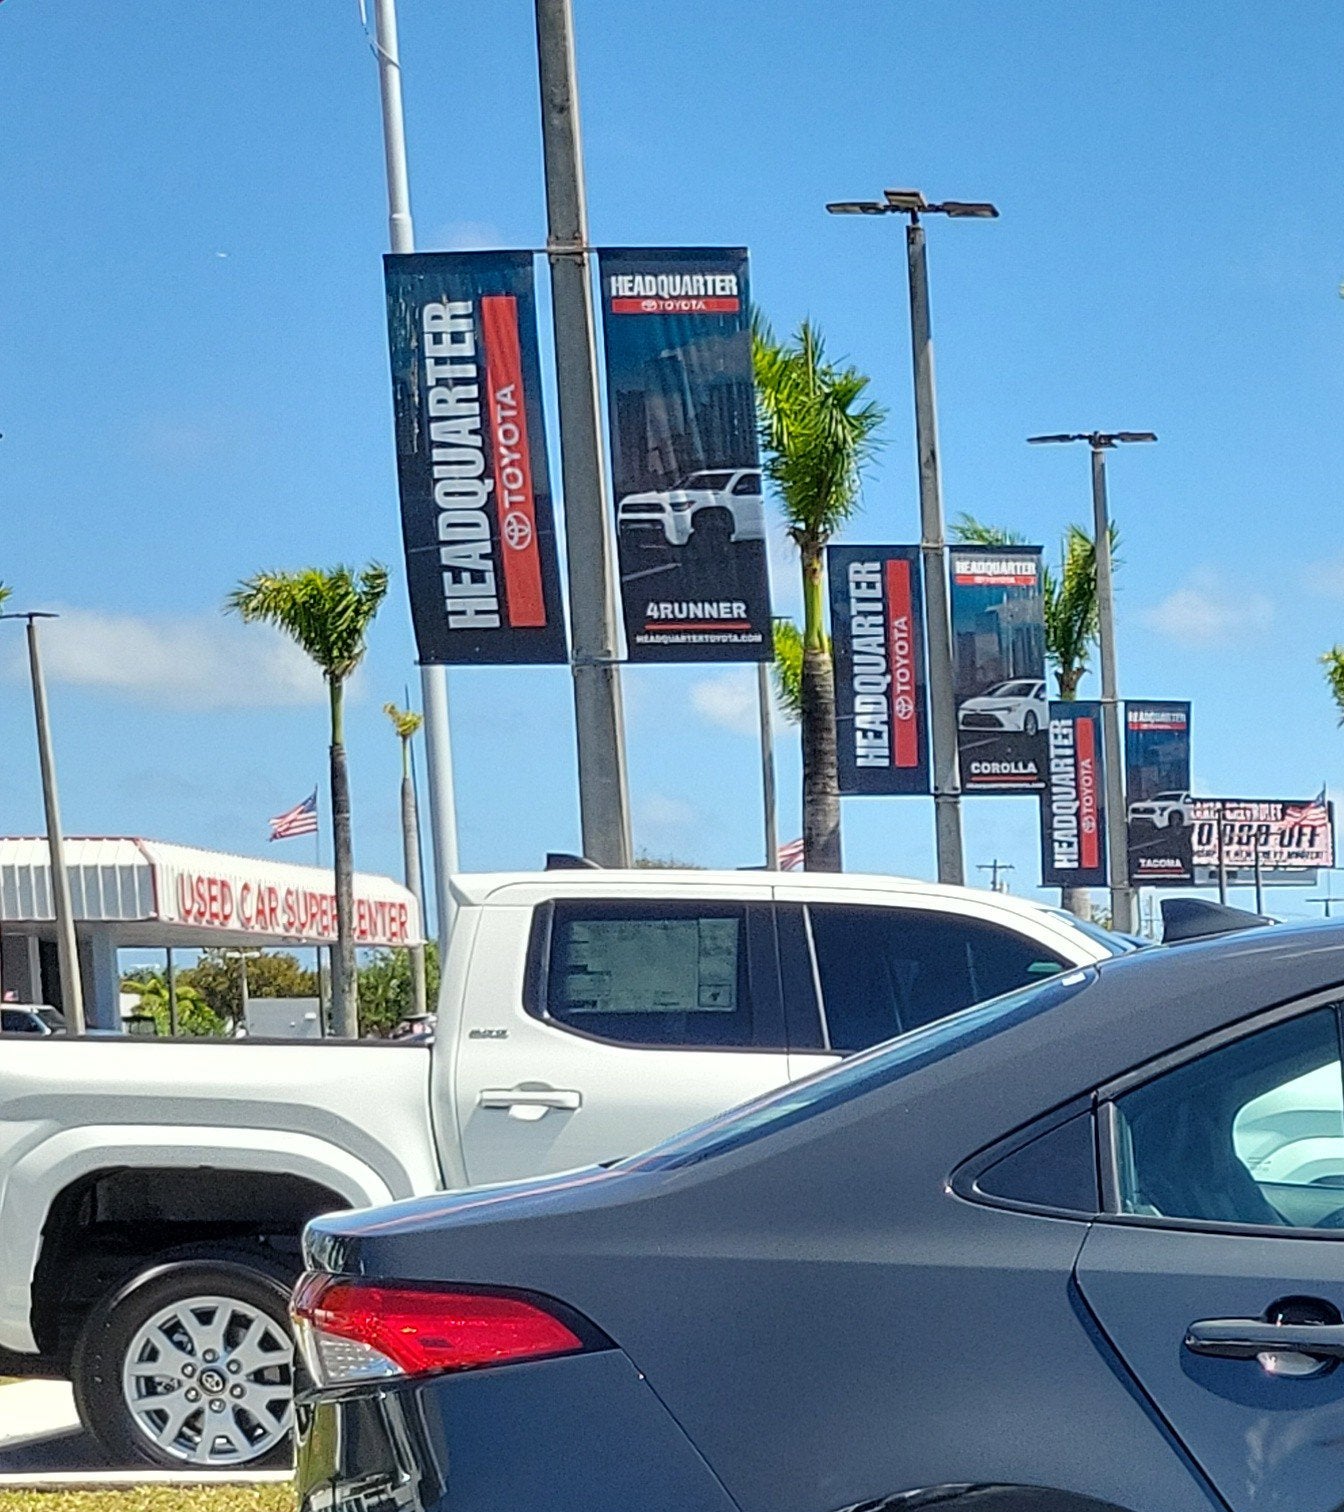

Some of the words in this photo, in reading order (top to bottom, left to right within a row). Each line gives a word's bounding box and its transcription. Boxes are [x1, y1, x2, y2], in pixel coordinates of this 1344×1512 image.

[610, 274, 738, 299] HEADQUARTER
[657, 300, 706, 311] TOYOTA
[423, 299, 501, 630] HEADQUARTER
[496, 383, 527, 507] TOYOTA
[955, 560, 1037, 576] HEADQUARTER
[646, 601, 748, 620] 4RUNNER
[849, 560, 891, 768] HEADQUARTER
[894, 616, 911, 693] TOYOTA
[970, 761, 1038, 774] COROLLA
[1050, 718, 1080, 869] HEADQUARTER
[1081, 758, 1094, 817] TOYOTA
[1138, 857, 1182, 869] TACOMA
[179, 872, 234, 925] USED
[240, 881, 280, 931] CAR
